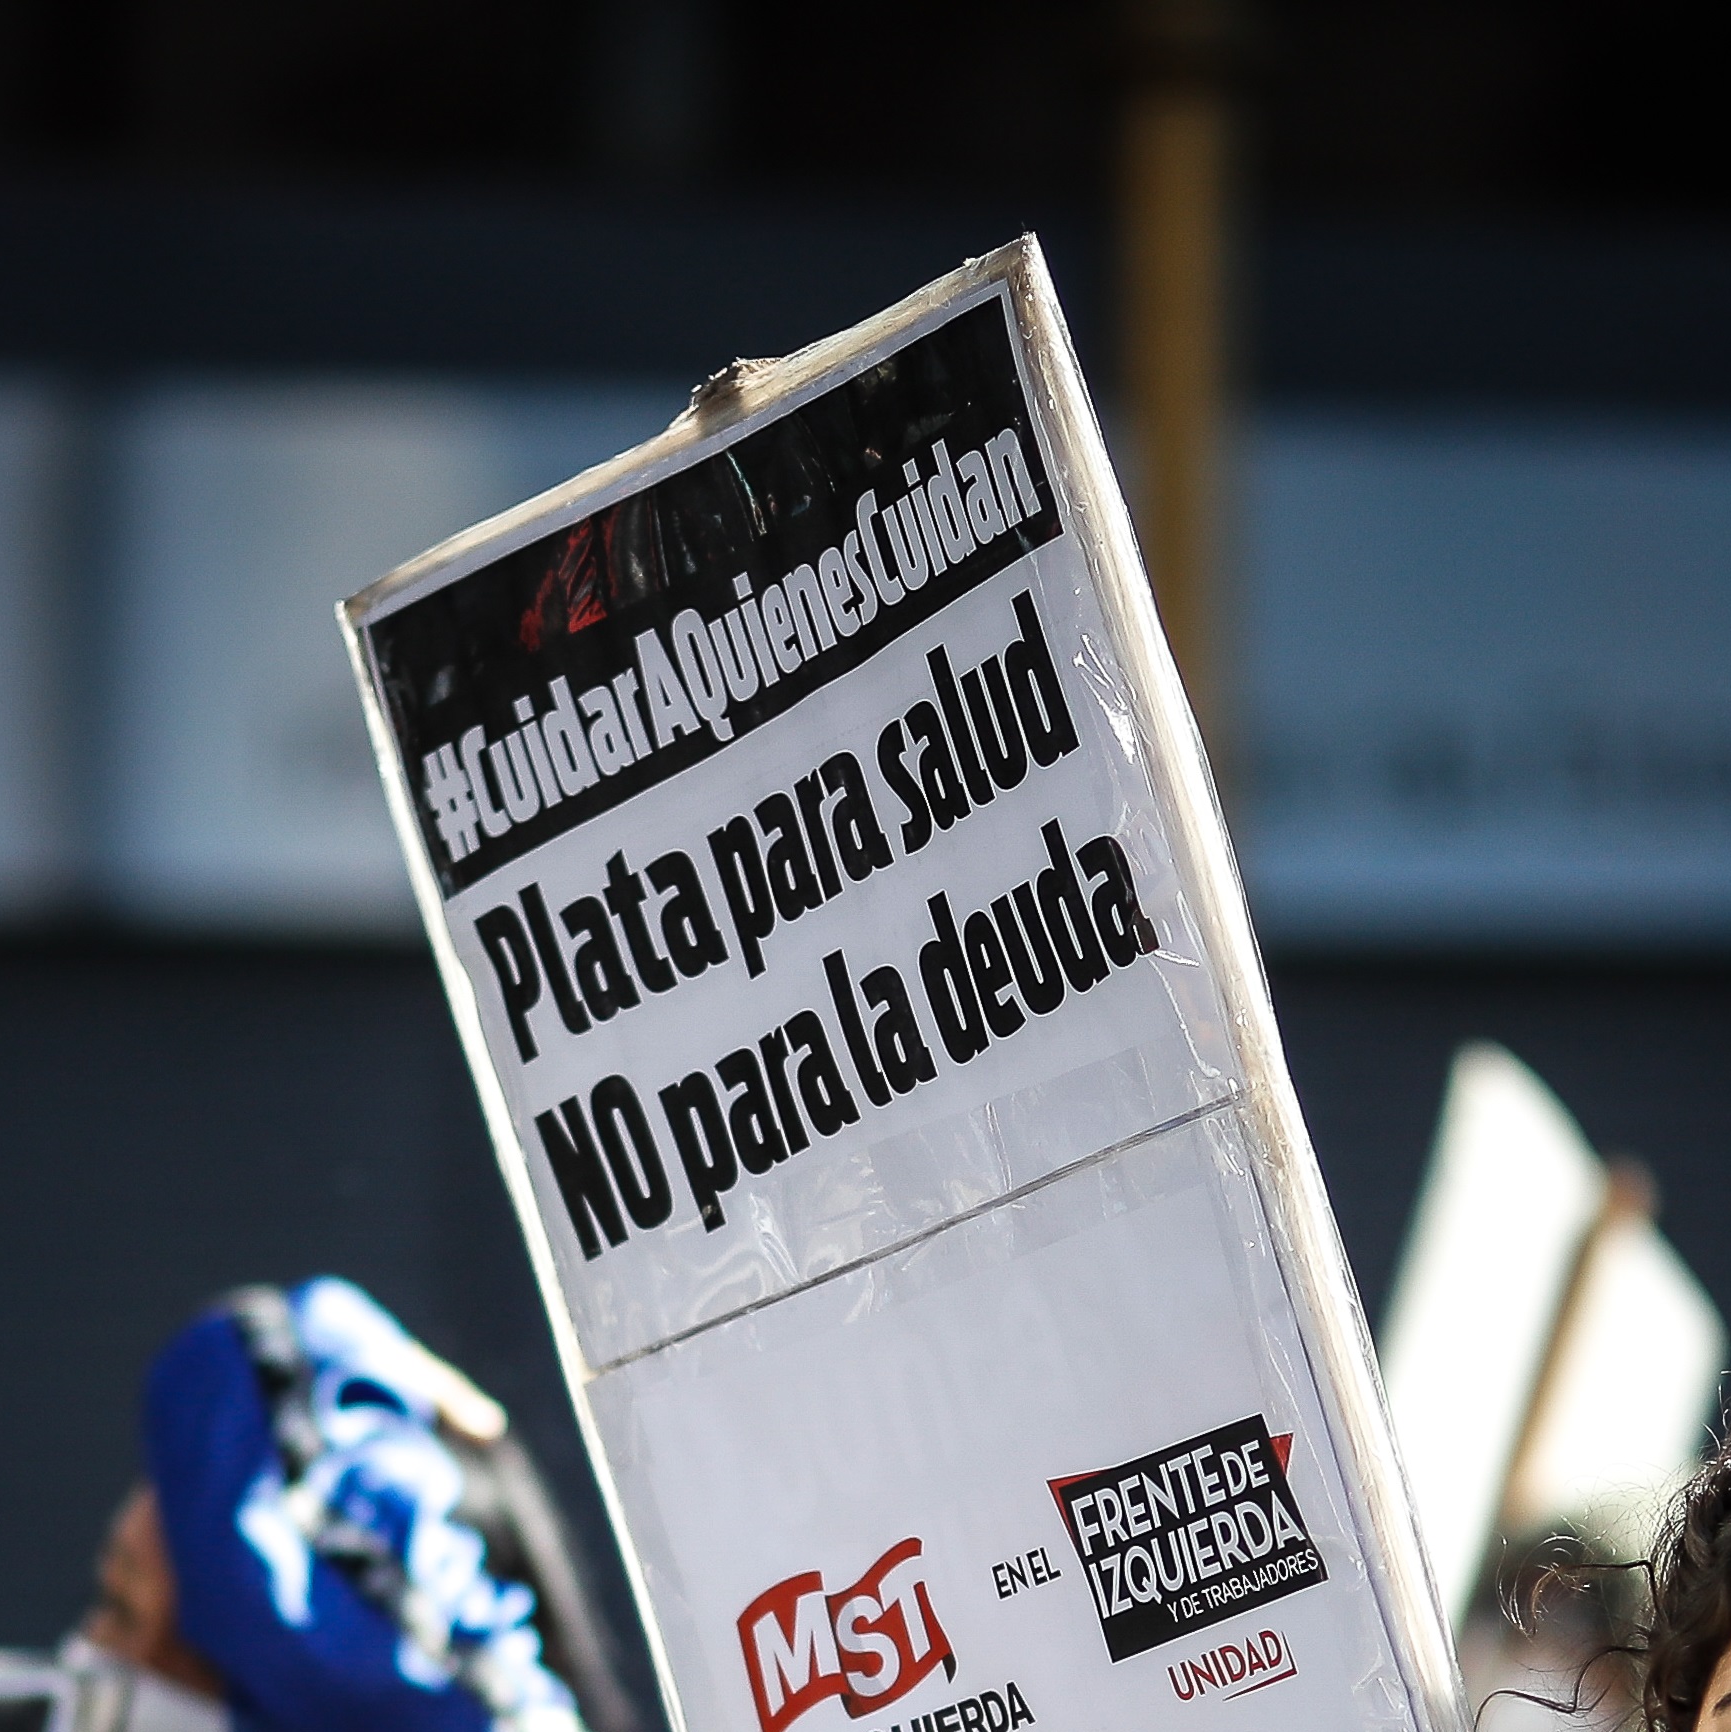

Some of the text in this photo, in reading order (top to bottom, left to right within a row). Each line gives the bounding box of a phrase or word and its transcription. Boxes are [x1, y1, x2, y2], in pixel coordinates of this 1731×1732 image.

[421, 425, 1042, 864] #CuidarAQuienesCuidan
[475, 845, 728, 1064] Plata
[706, 750, 895, 978] para
[875, 590, 1080, 858] salud
[534, 816, 1161, 1262] NO para la deuda
[1071, 1440, 1270, 1556] FRENTE DE
[1089, 1490, 1307, 1619] IZQUIERDA
[752, 1554, 931, 1718] MST
[991, 1547, 1062, 1600] EN EL
[1167, 1549, 1320, 1623] Y DE TRABAJADORES
[1167, 1630, 1283, 1701] UNIDAD
